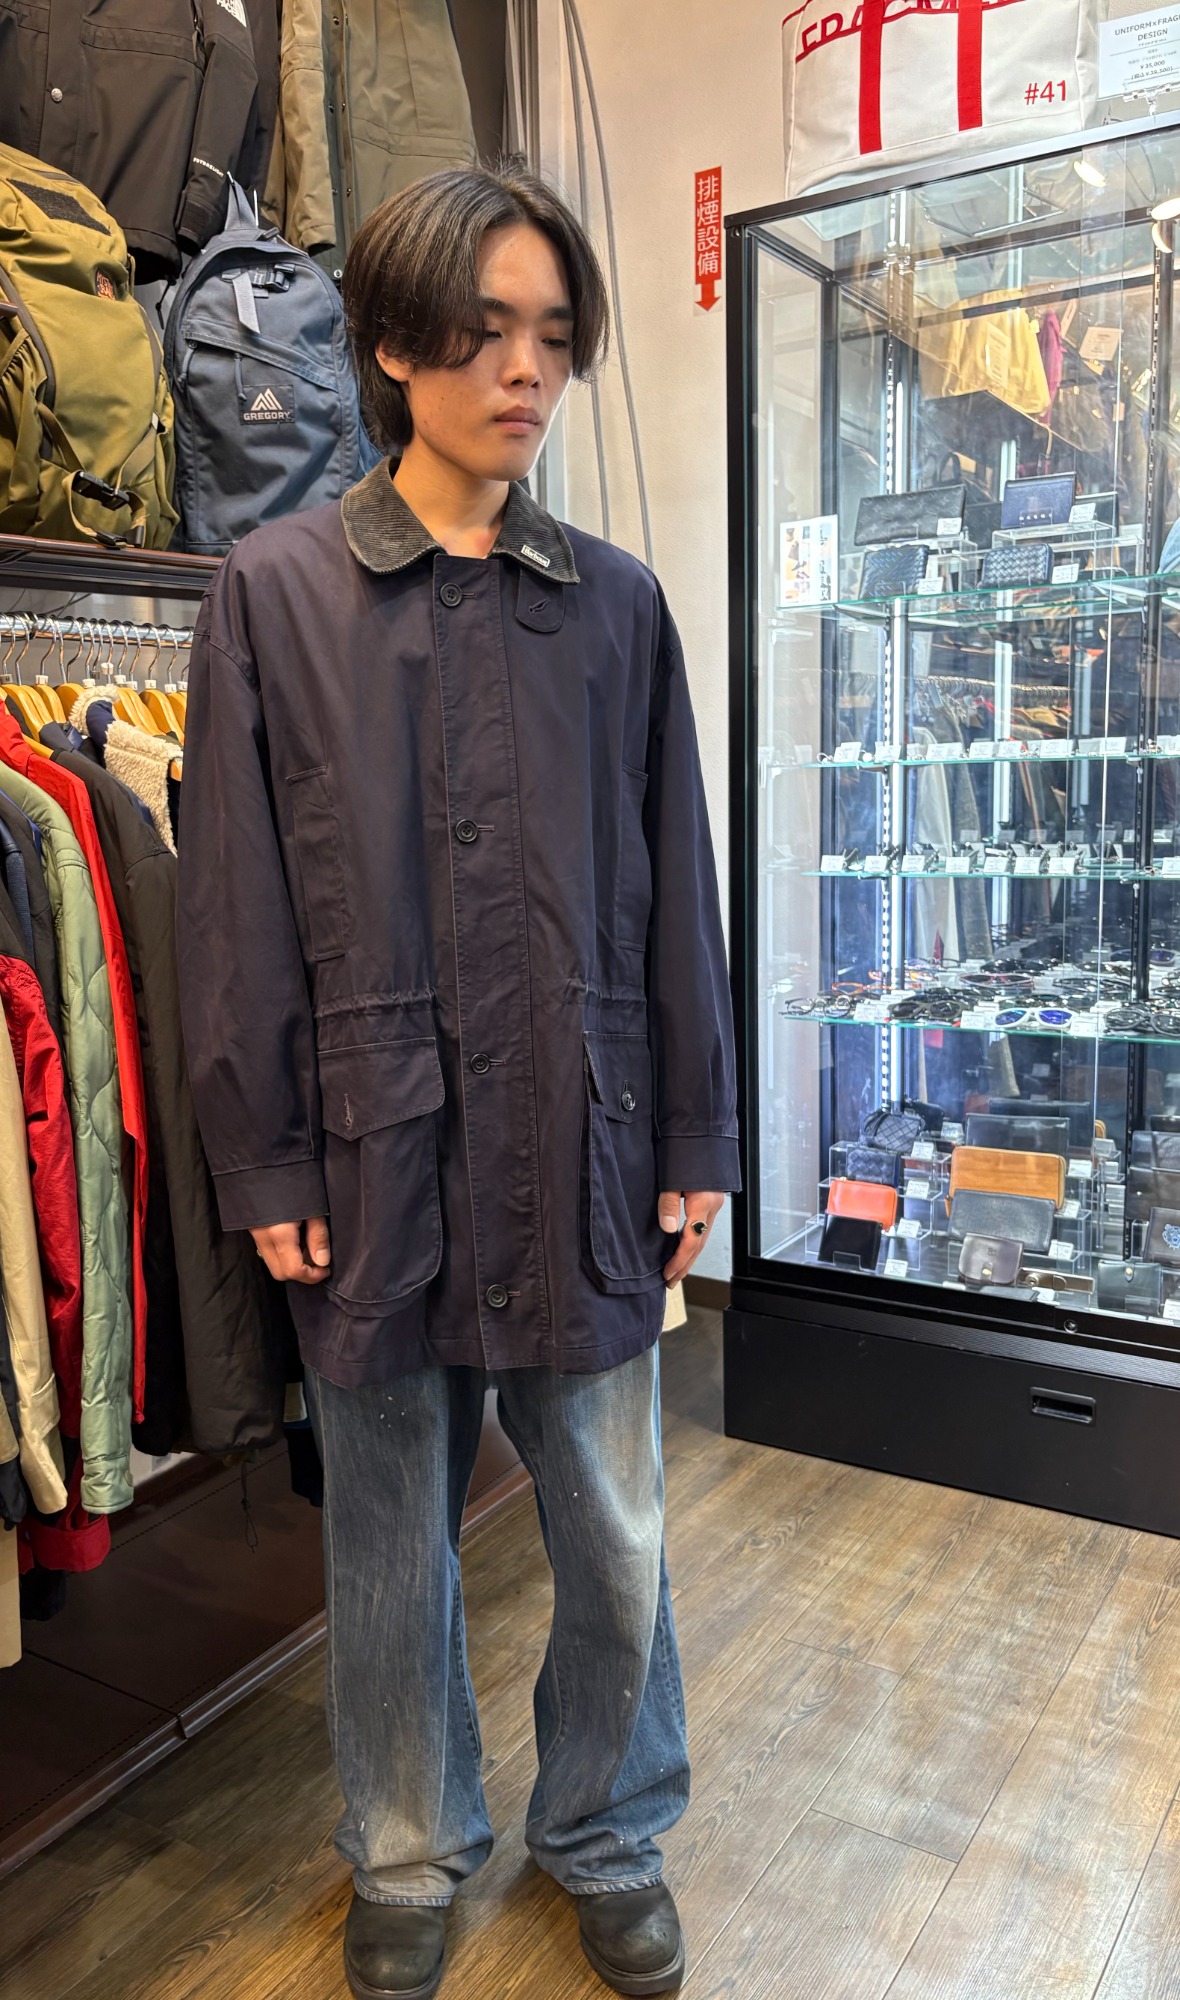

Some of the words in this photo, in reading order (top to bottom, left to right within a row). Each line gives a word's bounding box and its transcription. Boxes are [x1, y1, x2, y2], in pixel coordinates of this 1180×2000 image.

[1137, 28, 1168, 41] DESIGN
[1024, 79, 1066, 105] #41
[697, 174, 720, 277] 排煙設備
[243, 411, 290, 421] GREGORY
